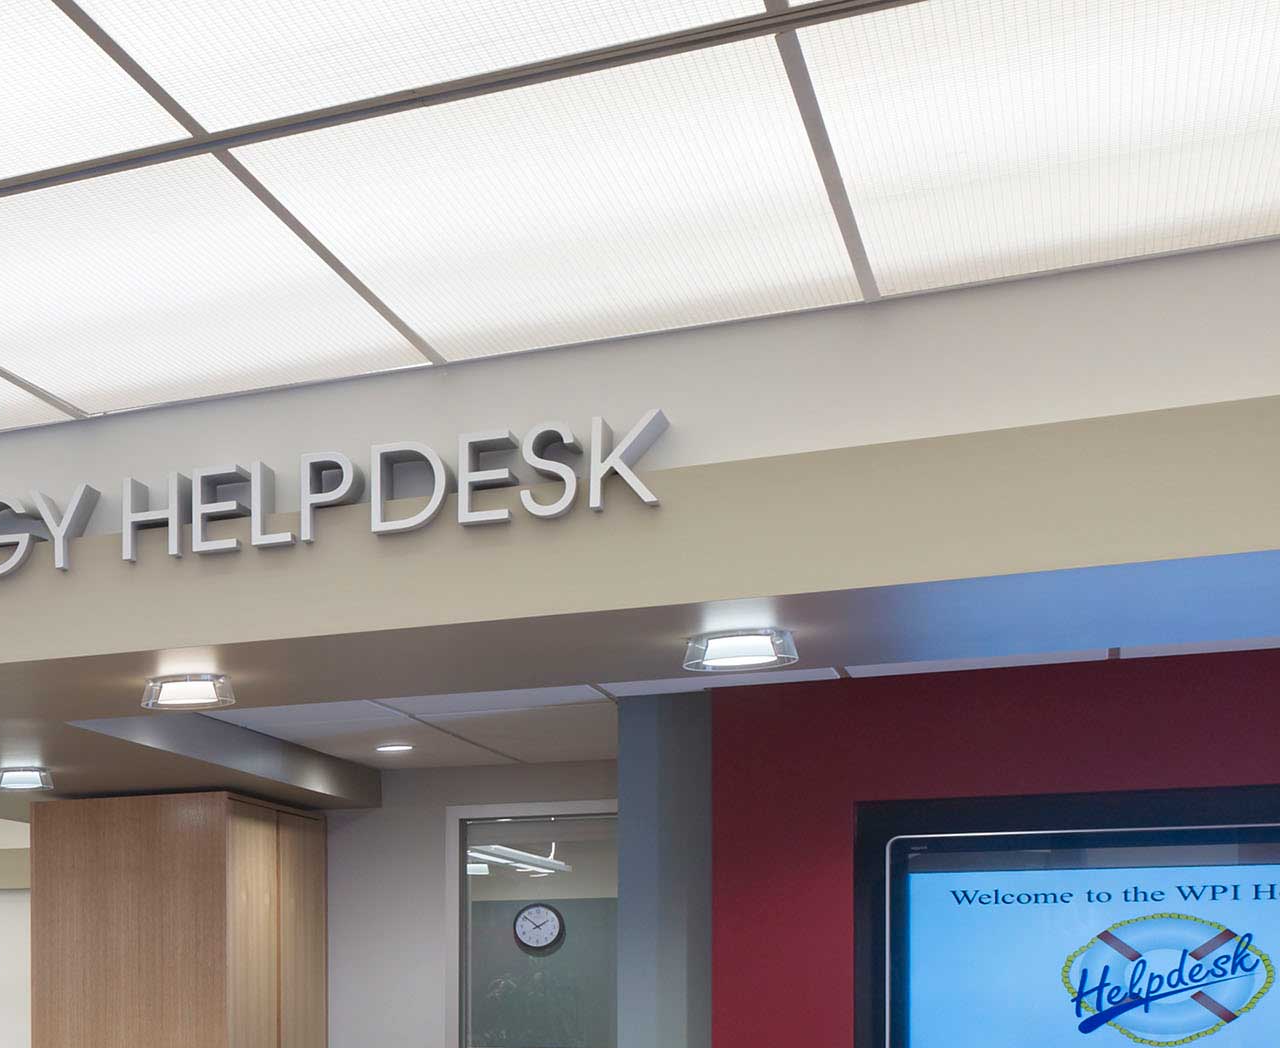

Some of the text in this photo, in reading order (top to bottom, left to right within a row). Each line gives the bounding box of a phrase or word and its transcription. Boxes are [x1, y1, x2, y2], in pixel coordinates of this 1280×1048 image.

[121, 408, 671, 563] HELPDESK
[949, 883, 1280, 906] Welcome to the WPI H
[1071, 932, 1261, 1018] Helpdesk
